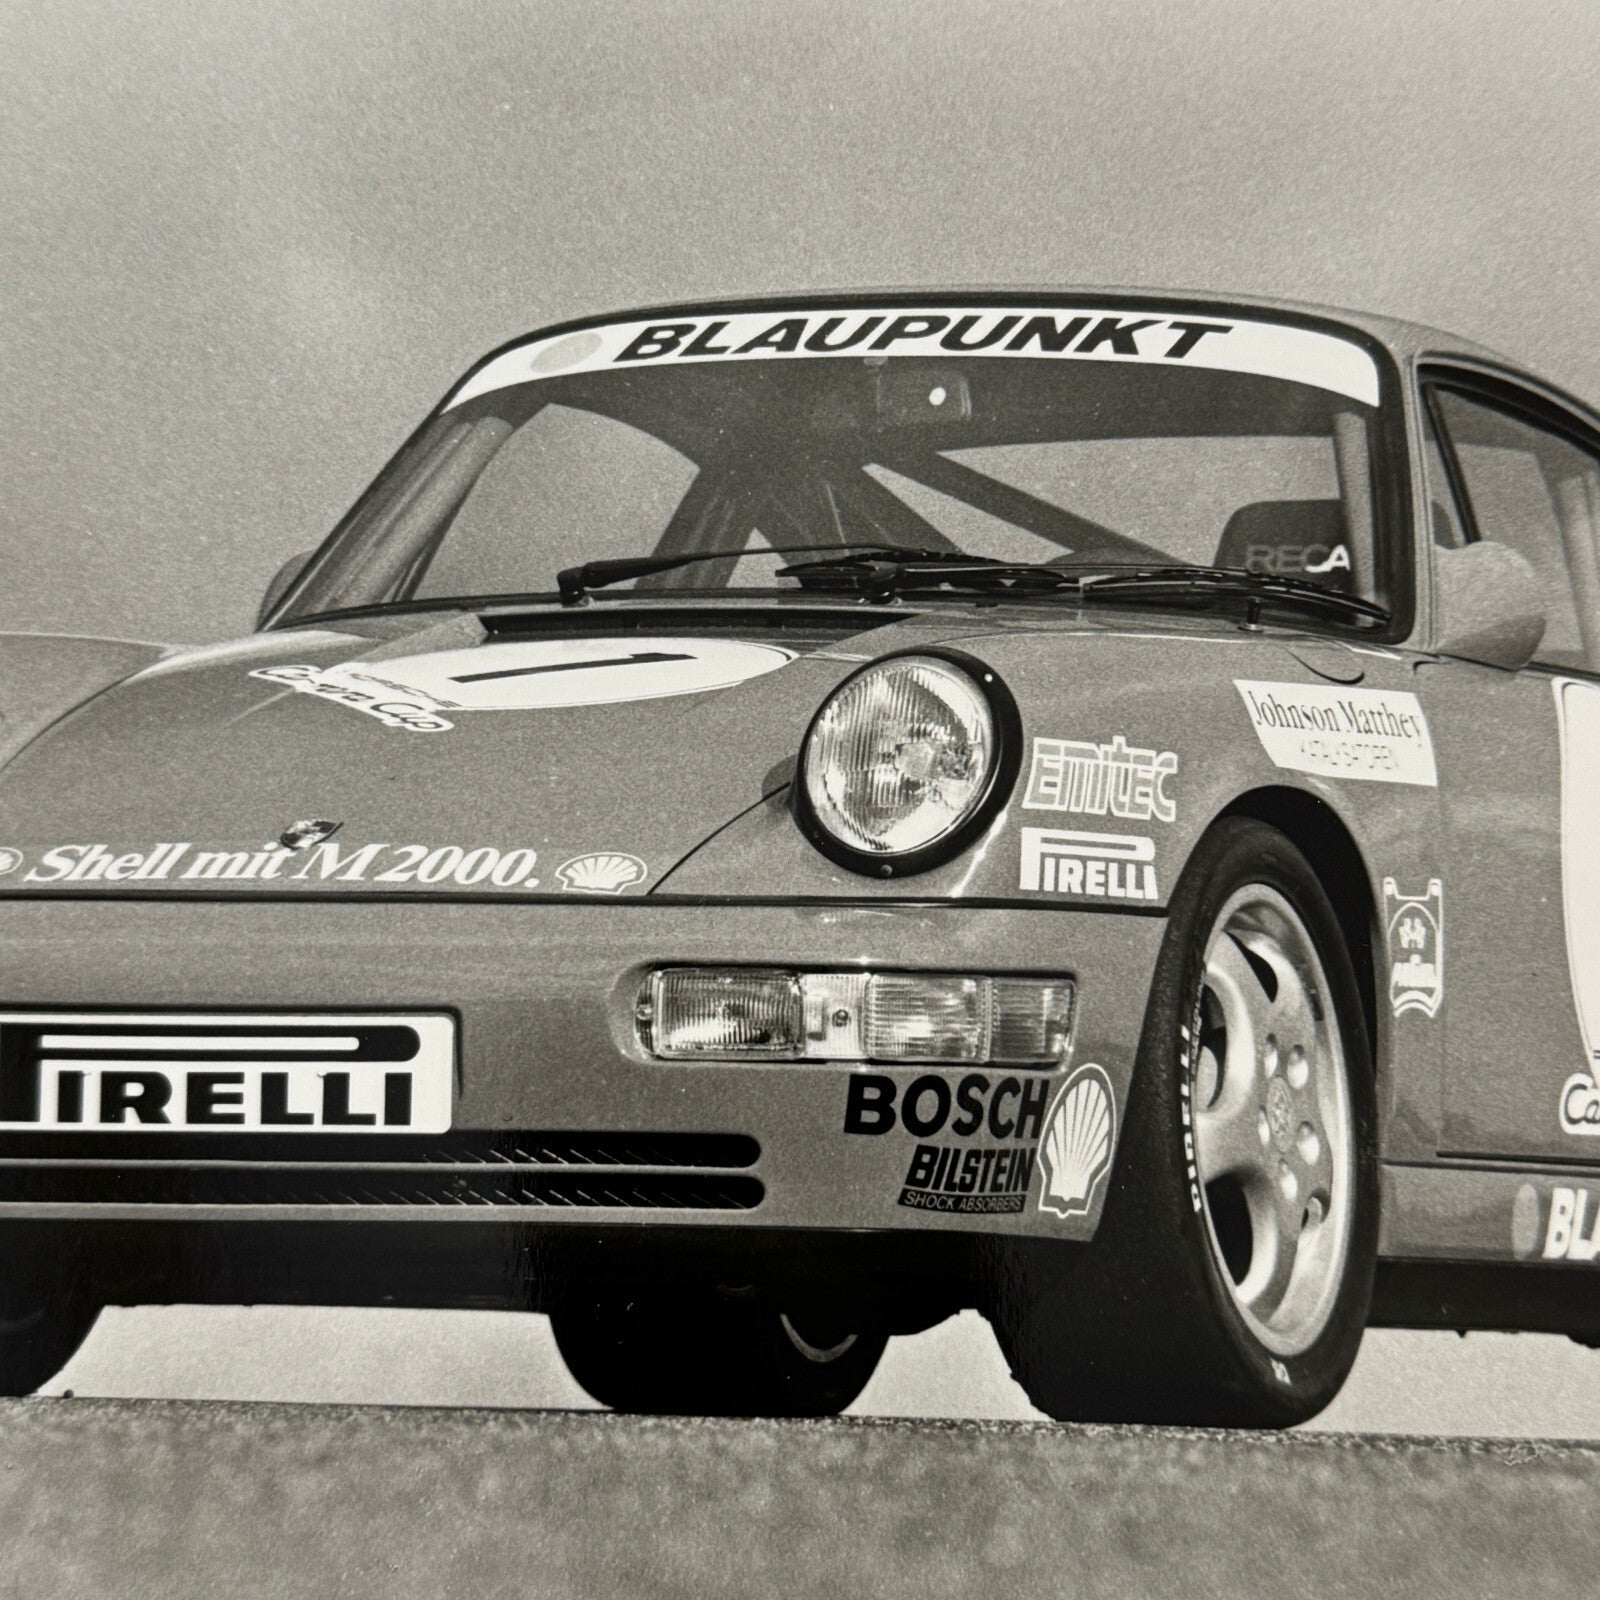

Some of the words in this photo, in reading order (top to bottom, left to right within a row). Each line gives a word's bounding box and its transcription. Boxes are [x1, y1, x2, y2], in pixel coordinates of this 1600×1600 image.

[614, 315, 1231, 362] BLAUPUNKT
[448, 652, 697, 683] 1
[1248, 690, 1341, 731] Johnson
[1337, 700, 1422, 747] Matthey
[23, 842, 193, 882] Shell
[178, 841, 297, 879] mit
[289, 843, 391, 881] M
[372, 844, 540, 888] 2000.
[1019, 827, 1159, 900] PIRELLI
[0, 1024, 421, 1126] PIRELLI
[843, 1073, 1050, 1140] BOSCH
[904, 1144, 1037, 1193] BILSTEIN
[903, 1190, 955, 1211] SHOCK
[958, 1196, 1022, 1213] ABSORBERS
[1541, 1187, 1600, 1260] BL
